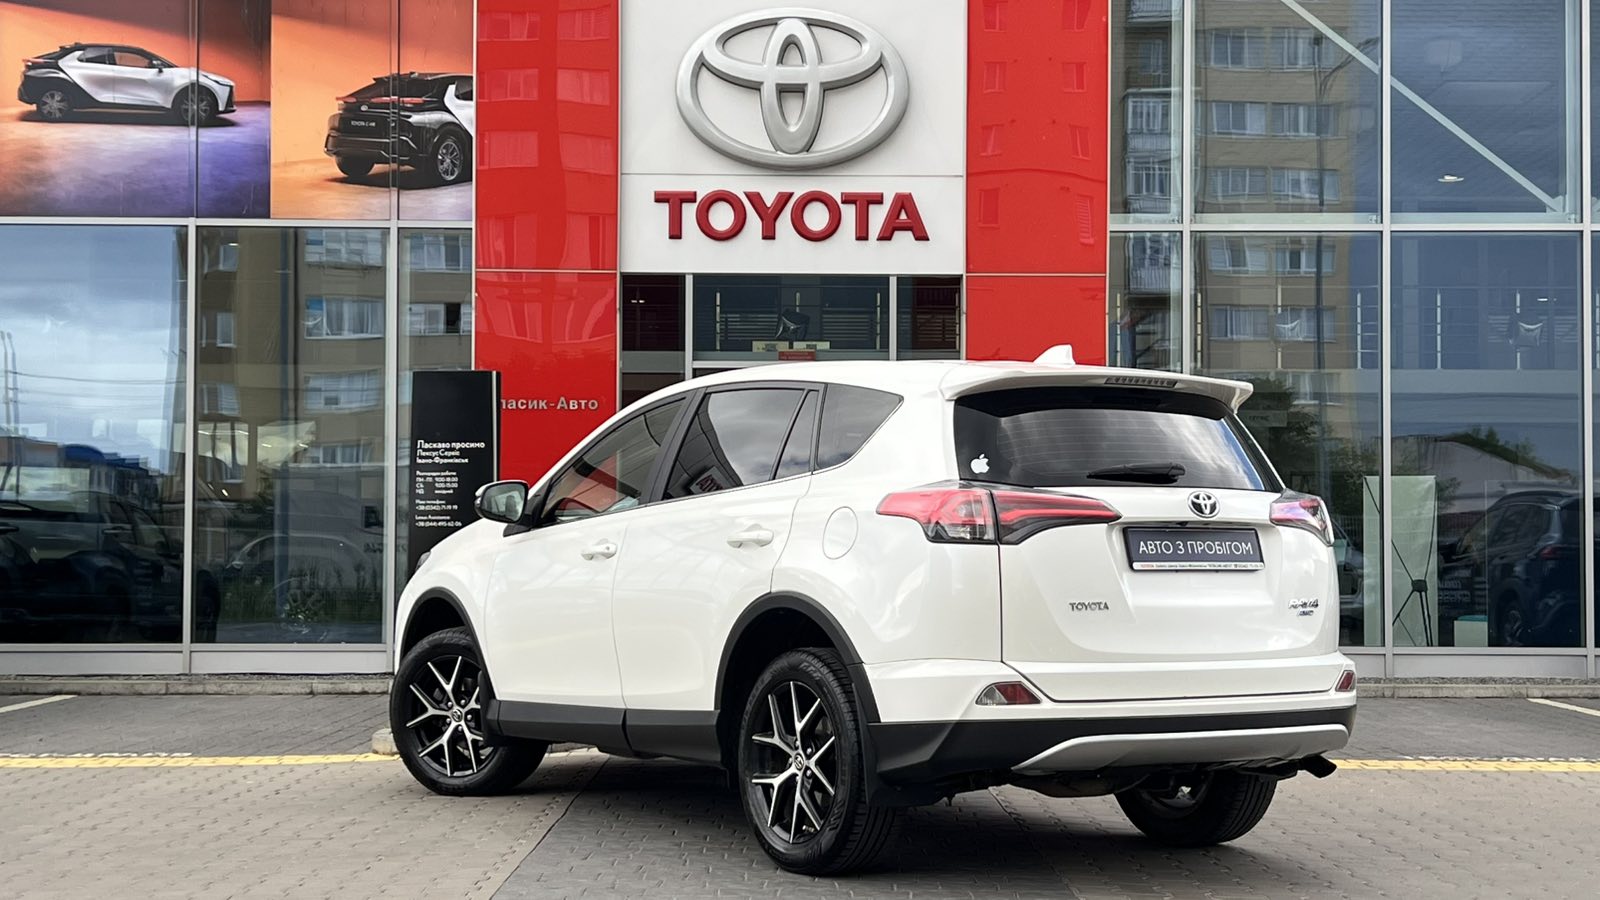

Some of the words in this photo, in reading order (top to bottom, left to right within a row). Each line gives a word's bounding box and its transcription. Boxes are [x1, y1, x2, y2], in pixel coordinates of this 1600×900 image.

[653, 188, 930, 242] TOYOTA
[417, 440, 450, 449] Ласкаво
[451, 442, 486, 450] просимо
[1139, 541, 1173, 554] АВТО
[1175, 541, 1185, 554] З
[1187, 541, 1254, 555] ПРОБІГОМ
[1069, 601, 1109, 611] TOYOTA
